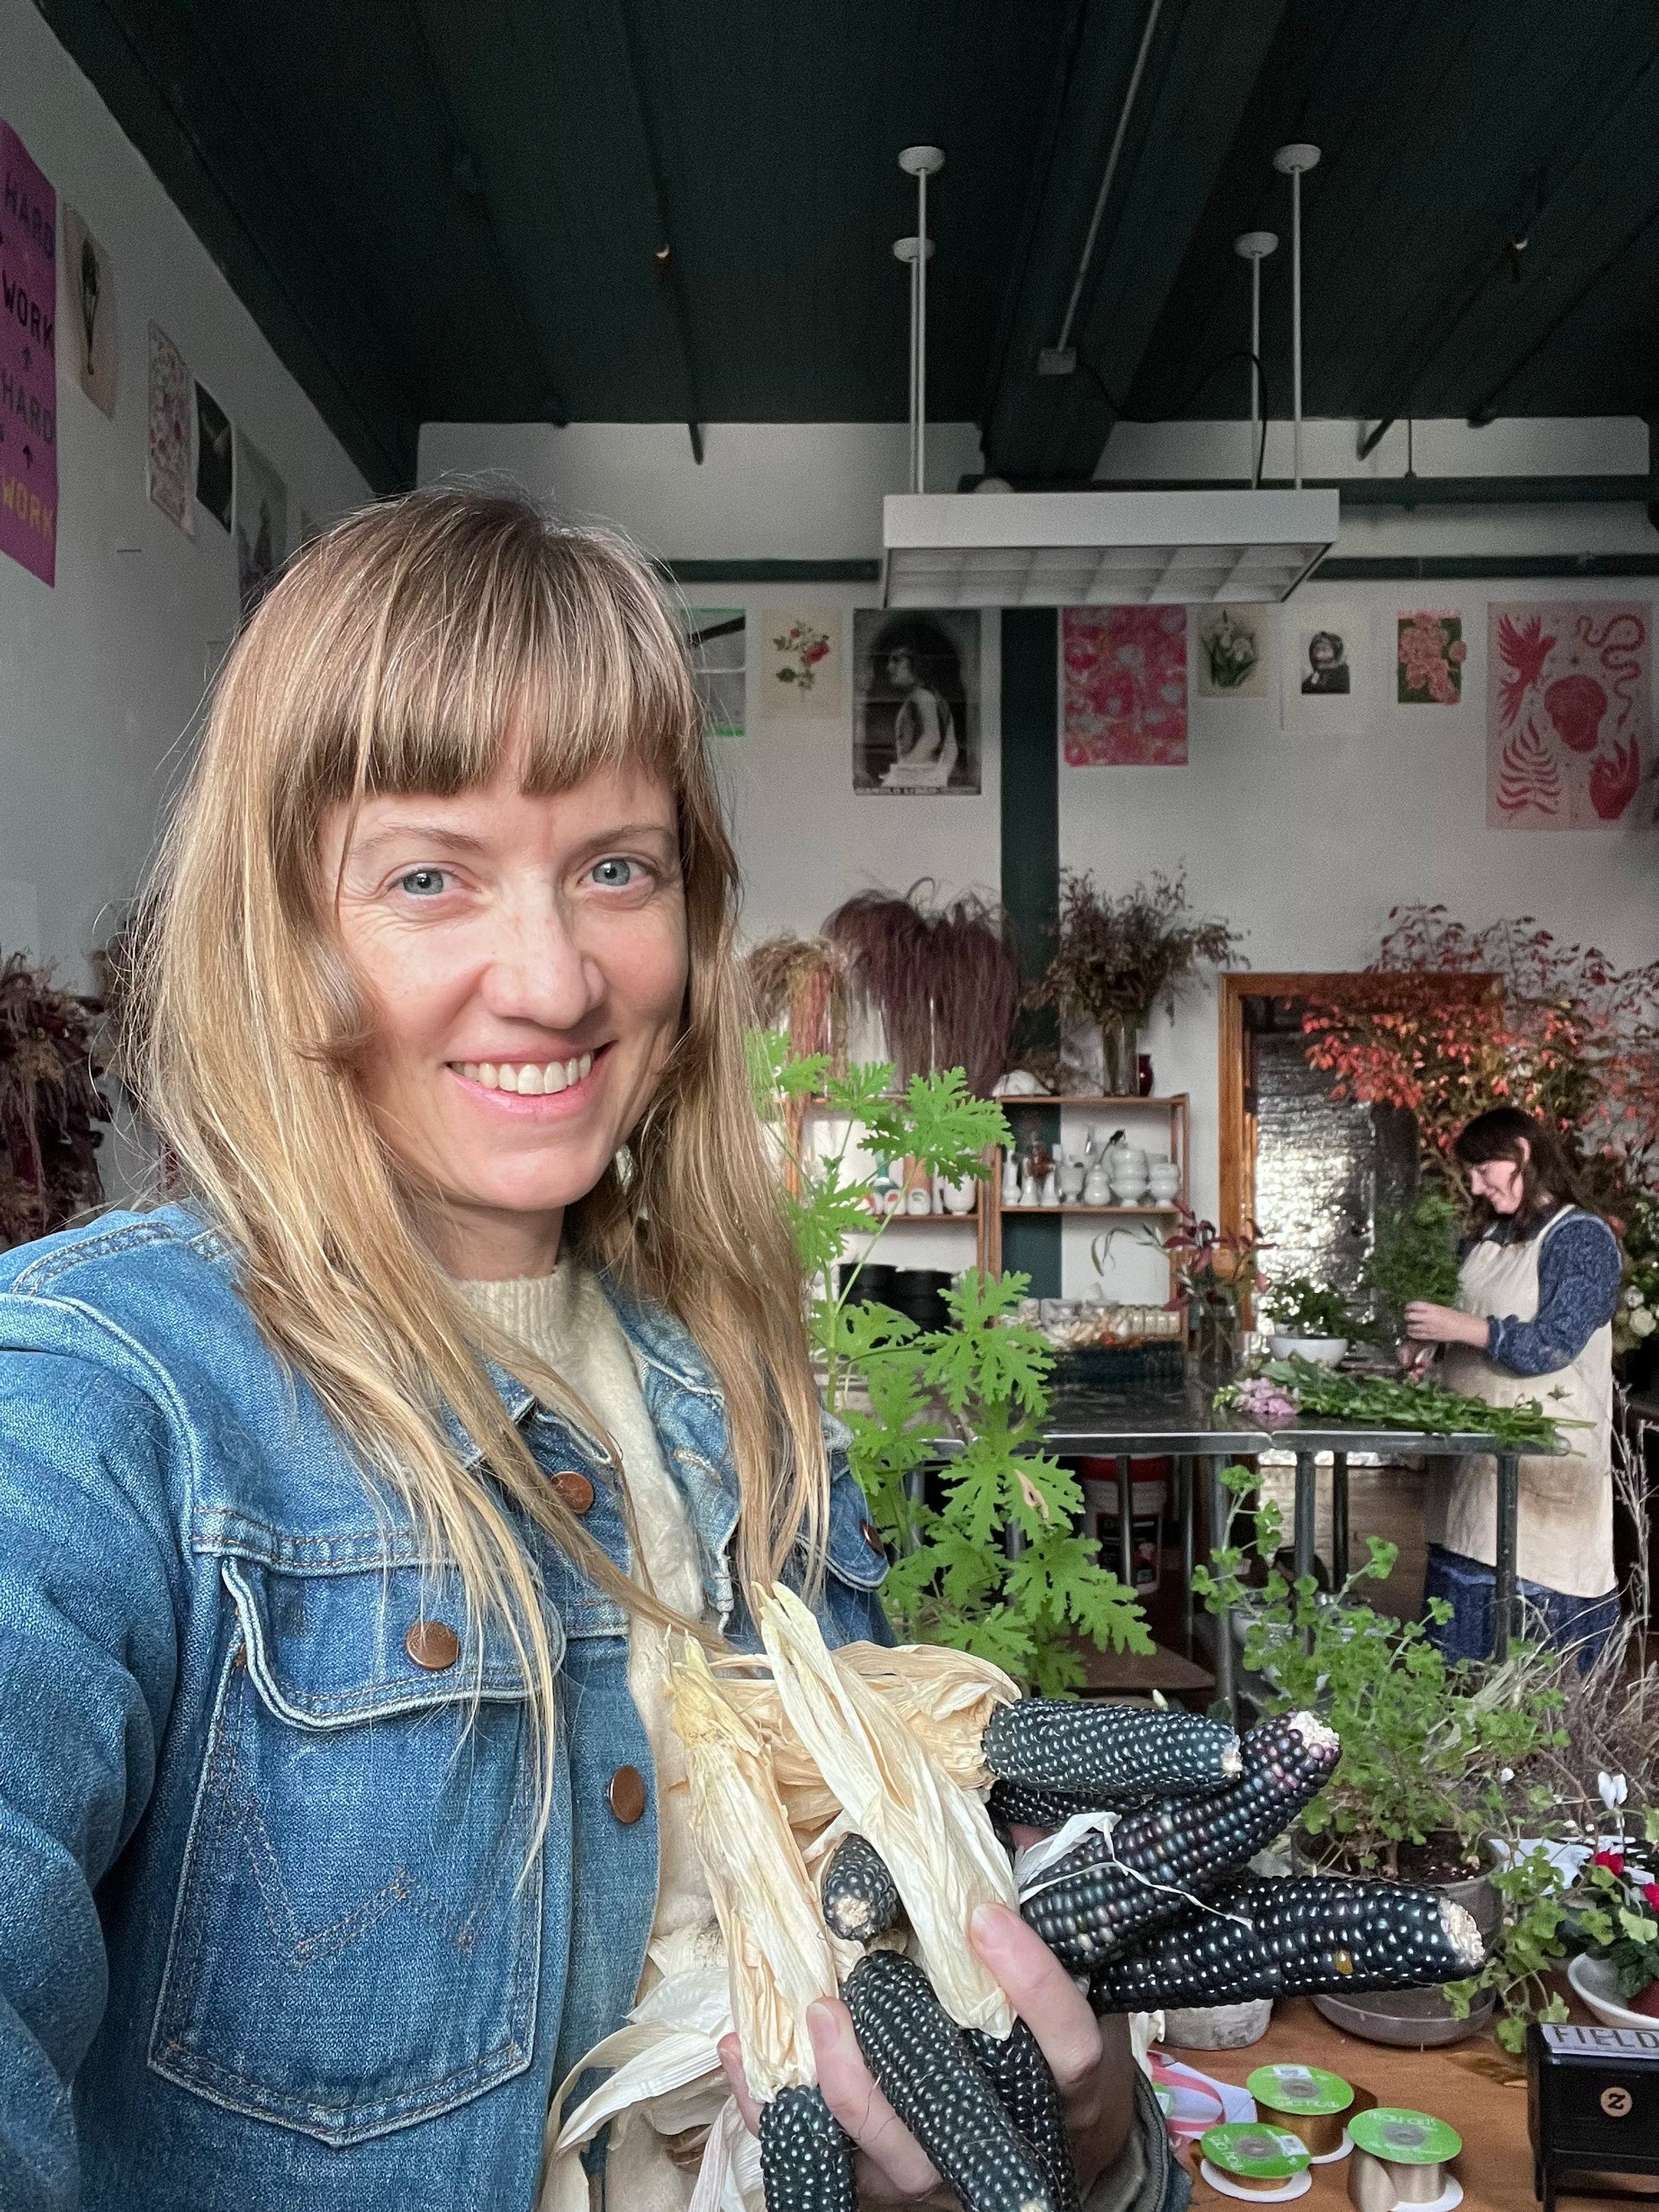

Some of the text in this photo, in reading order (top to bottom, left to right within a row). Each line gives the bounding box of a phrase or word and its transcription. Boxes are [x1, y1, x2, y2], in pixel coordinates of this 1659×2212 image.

[5, 170, 55, 260] HARD
[3, 268, 55, 358] WORK
[1, 367, 55, 444] HARD
[2, 473, 54, 547] WORK
[1552, 2026, 1659, 2049] FIELD
